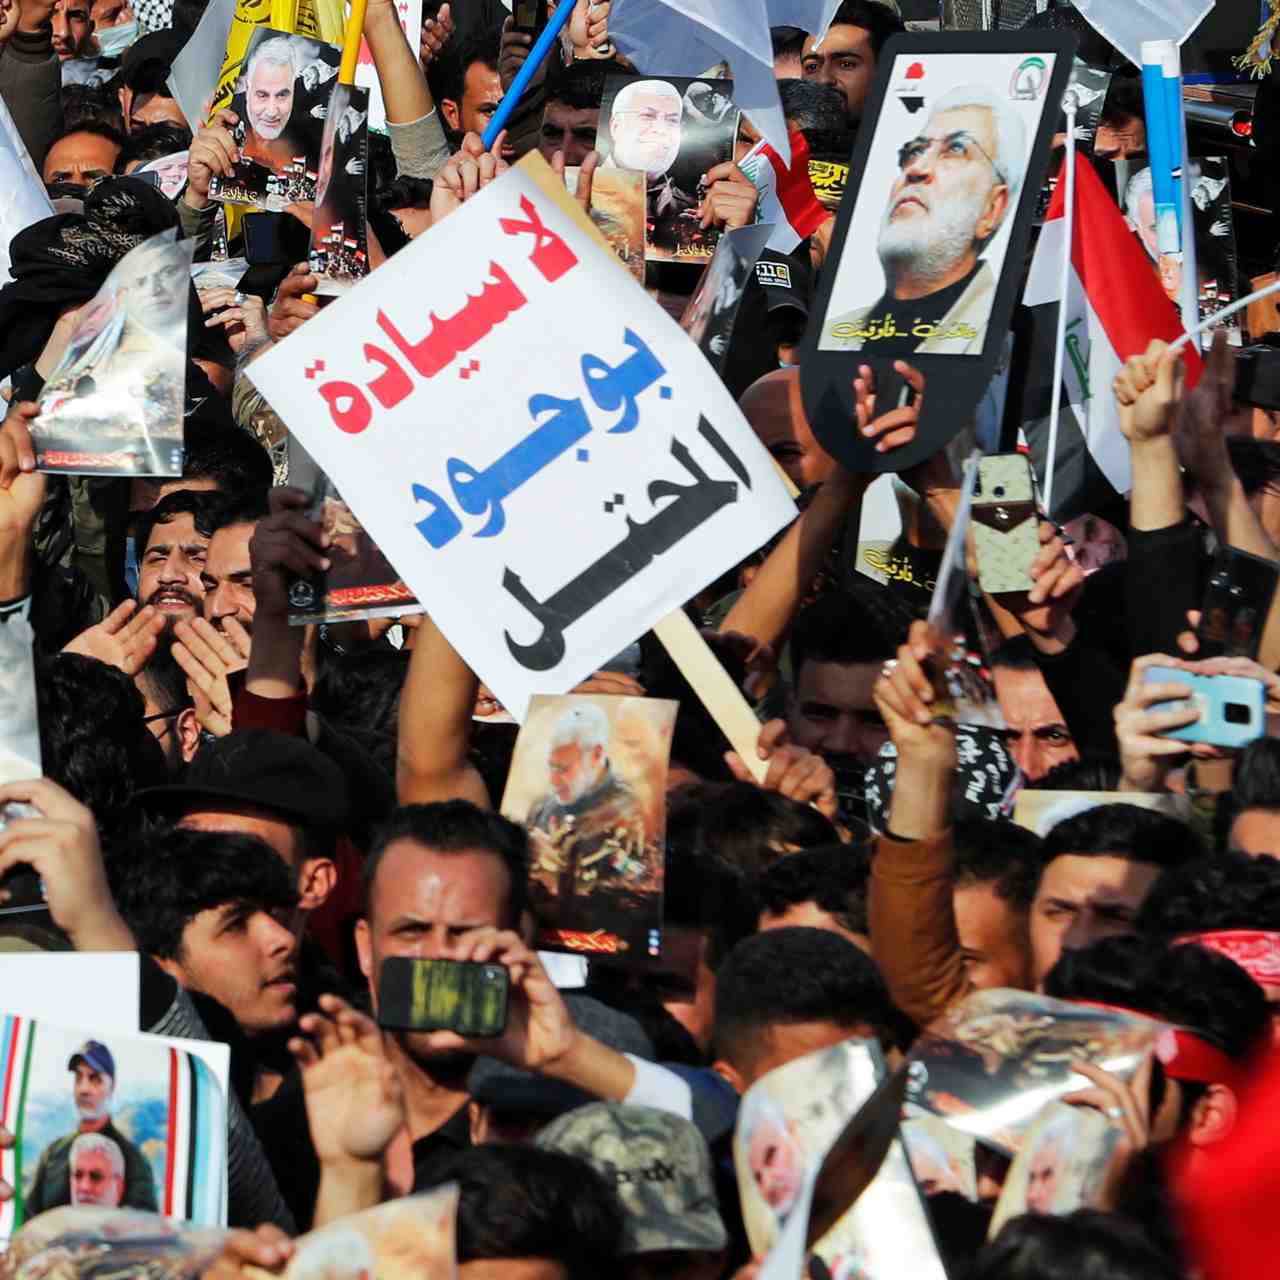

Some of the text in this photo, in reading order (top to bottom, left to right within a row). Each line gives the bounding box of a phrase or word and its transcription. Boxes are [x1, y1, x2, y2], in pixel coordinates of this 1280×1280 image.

[304, 194, 580, 435] لا سيادة
[412, 328, 671, 549] بوجود
